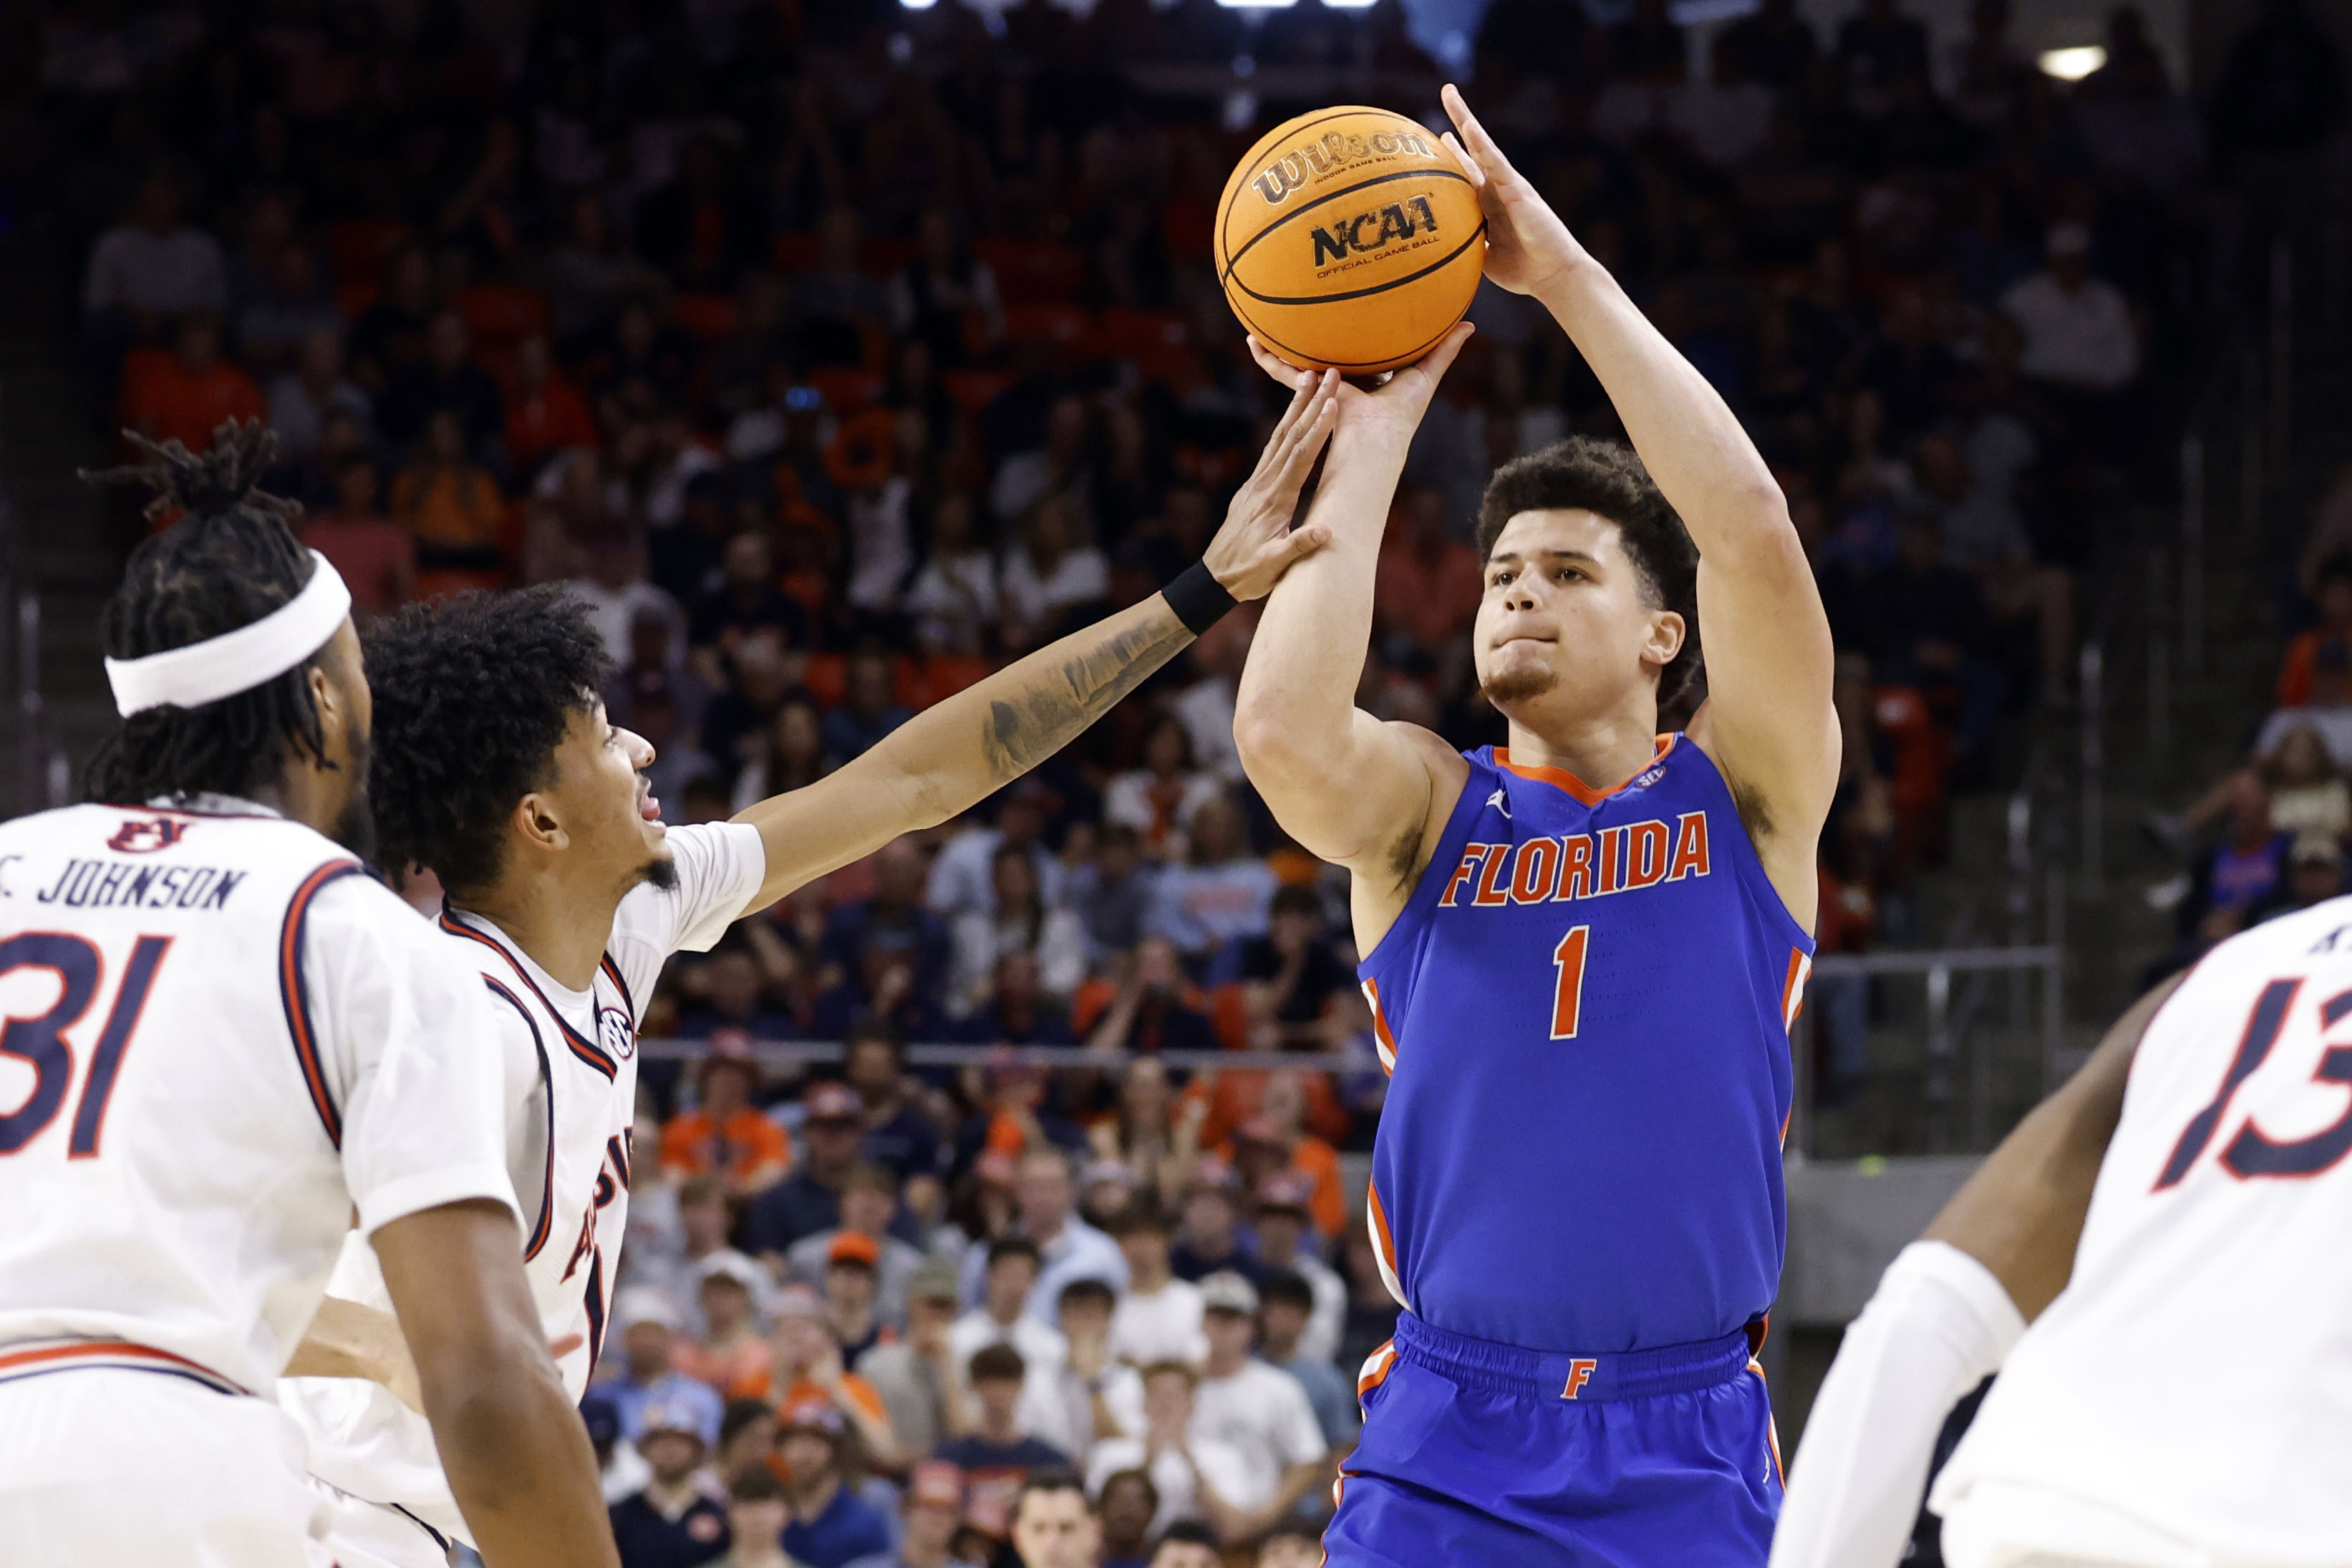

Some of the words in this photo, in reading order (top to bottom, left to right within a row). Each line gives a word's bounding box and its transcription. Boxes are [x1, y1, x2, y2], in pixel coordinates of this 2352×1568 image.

[1252, 131, 1437, 205] Wilson
[1315, 167, 1347, 185] INDOOR
[1349, 159, 1373, 170] GAME
[1310, 194, 1438, 269] NCAA
[1317, 258, 1372, 279] OFFICIAL
[1374, 246, 1410, 262] GAME
[1412, 236, 1441, 249] BALL
[37, 857, 249, 911] JOHNSON
[1438, 810, 1710, 908] FLORIDA
[1550, 924, 1590, 1041] 1
[0, 929, 175, 1162] 31
[2147, 974, 2352, 1197] 13
[1559, 1358, 1597, 1400] F
